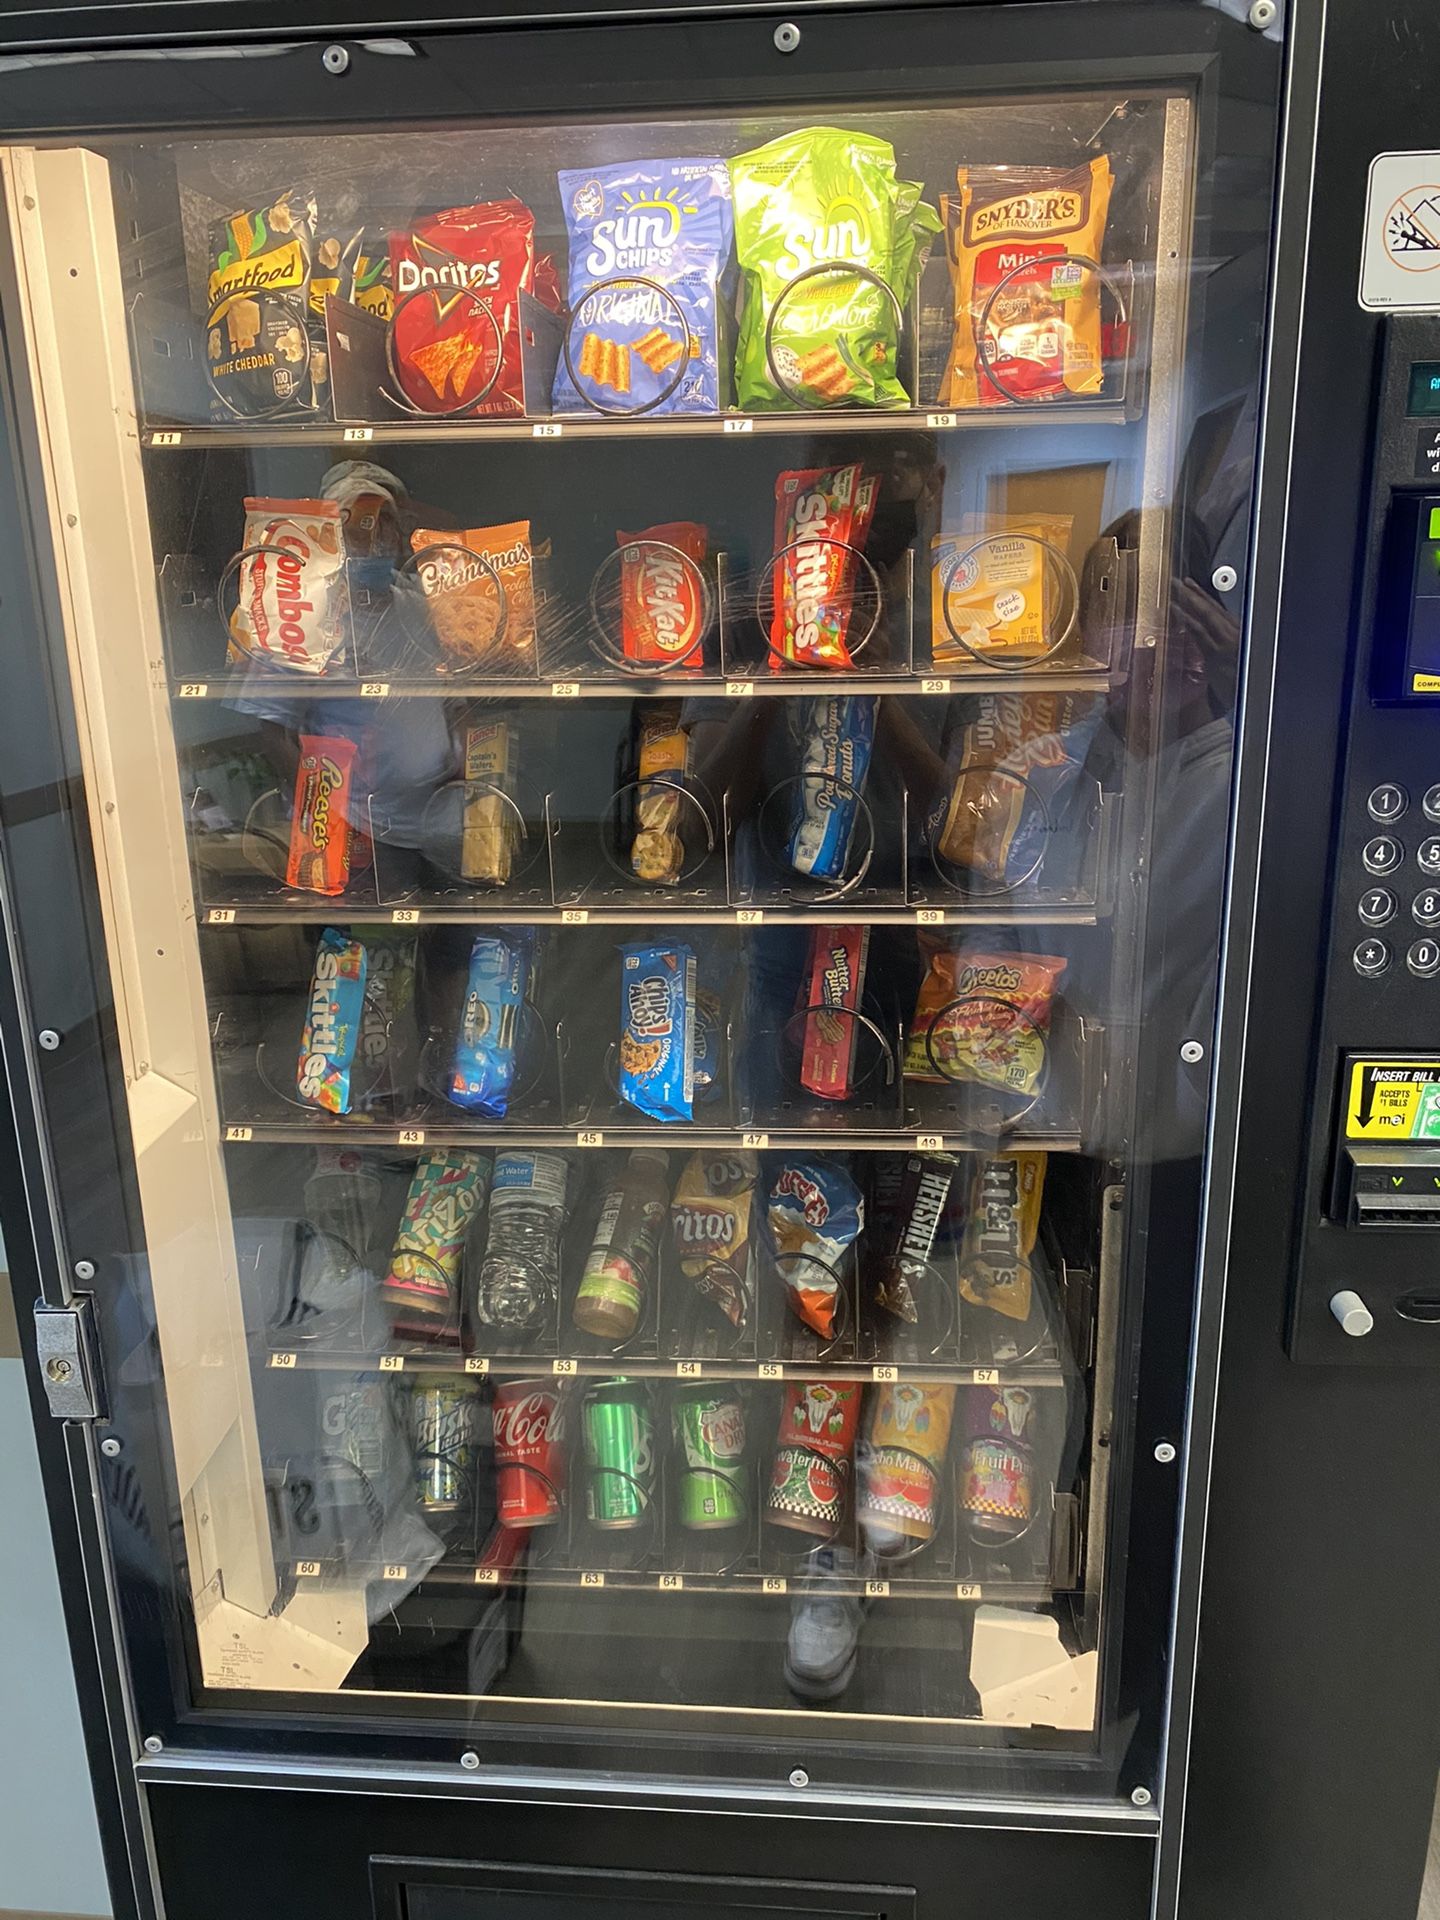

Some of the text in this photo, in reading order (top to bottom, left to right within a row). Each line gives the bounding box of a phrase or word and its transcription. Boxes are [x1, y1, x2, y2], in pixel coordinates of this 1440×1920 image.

[976, 198, 1077, 232] SNYDER'S
[1006, 218, 1053, 230] HANOVER
[586, 213, 681, 276] Sun
[775, 216, 871, 279] Sun
[615, 249, 673, 271] CHIPS
[399, 258, 501, 292] Doritos
[213, 353, 276, 378] WHITE CHEDDAR
[933, 416, 950, 426] 19
[540, 426, 554, 436] 15
[730, 422, 746, 431] 17
[158, 433, 175, 443] 11
[350, 430, 365, 439] 13
[988, 541, 1026, 555] Vanilla
[418, 541, 532, 597] Grandma's
[185, 687, 201, 696] 21
[365, 684, 382, 694] 23
[557, 685, 573, 694] 25
[731, 685, 747, 694] 27
[927, 682, 943, 691] 29
[1060, 696, 1074, 737] Glazed
[821, 701, 842, 745] Sugar
[977, 696, 996, 749] JUMB
[312, 756, 344, 850] Reese's
[1381, 793, 1389, 809] 1
[1374, 845, 1385, 861] 4
[1371, 896, 1381, 912] 7
[1423, 896, 1434, 912] 8
[214, 911, 227, 921] 31
[397, 911, 412, 921] 33
[566, 911, 581, 921] 35
[741, 911, 756, 921] 37
[922, 911, 937, 921] 39
[832, 946, 850, 991] Nutter
[957, 963, 1024, 995] Cheetos
[824, 969, 842, 1006] Butte
[653, 1038, 672, 1076] ORIGINAL
[1010, 1067, 1025, 1079] 170
[1370, 1067, 1435, 1082] INSERT BILL
[1379, 1089, 1411, 1098] ACCEPTS
[1389, 1098, 1408, 1108] BILLS
[1379, 1113, 1406, 1126] mei
[232, 1129, 246, 1138] 41
[404, 1132, 418, 1141] 43
[582, 1134, 596, 1143] 45
[748, 1135, 762, 1144] 47
[921, 1138, 937, 1148] 49
[505, 1166, 529, 1176] Water
[402, 1176, 484, 1276] AriZon
[276, 1355, 290, 1364] 50
[384, 1358, 398, 1367] 51
[469, 1360, 484, 1369] 52
[557, 1361, 571, 1371] 53
[681, 1364, 695, 1373] 54
[763, 1366, 777, 1375] 55
[877, 1368, 892, 1378] 56
[978, 1371, 992, 1381] 57
[516, 1447, 541, 1455] TASTE
[974, 1450, 1009, 1471] Fruit
[301, 1563, 315, 1572] 60
[388, 1566, 401, 1576] 61
[479, 1570, 493, 1580] 62
[585, 1573, 599, 1583] 63
[663, 1577, 677, 1587] 64
[766, 1580, 780, 1590] 65
[870, 1583, 884, 1593] 66
[961, 1586, 976, 1596] 67
[220, 1666, 236, 1675] TSL
